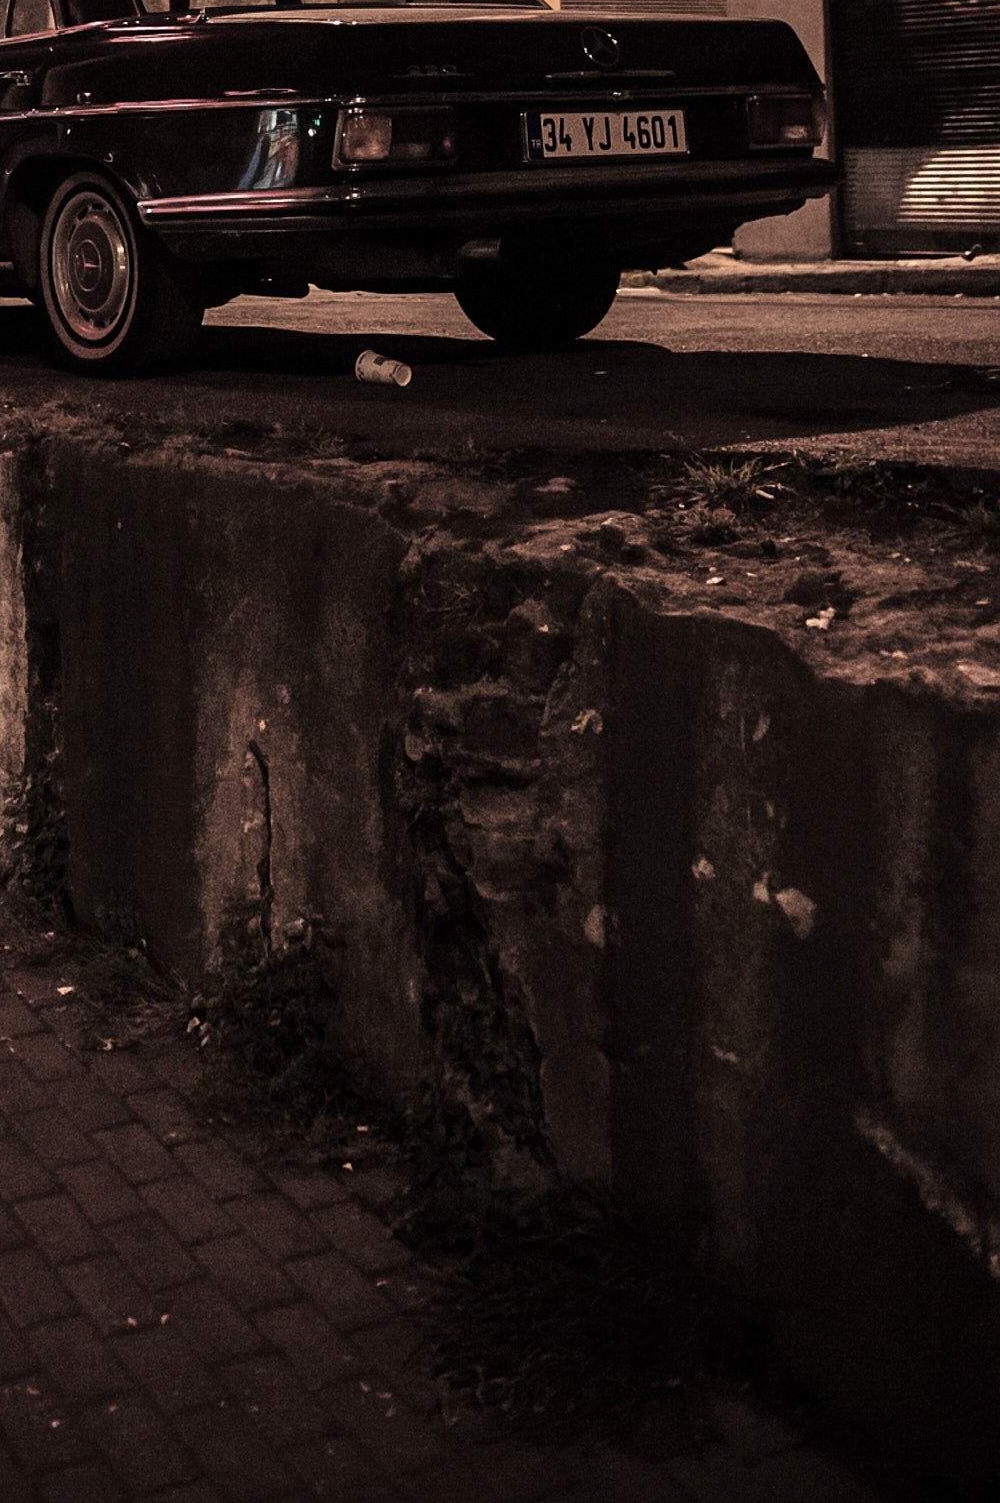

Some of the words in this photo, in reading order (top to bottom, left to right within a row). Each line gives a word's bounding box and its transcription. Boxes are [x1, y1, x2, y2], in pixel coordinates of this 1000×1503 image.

[543, 118, 571, 152] 34
[582, 117, 611, 150] YJ
[623, 115, 678, 149] 4601
